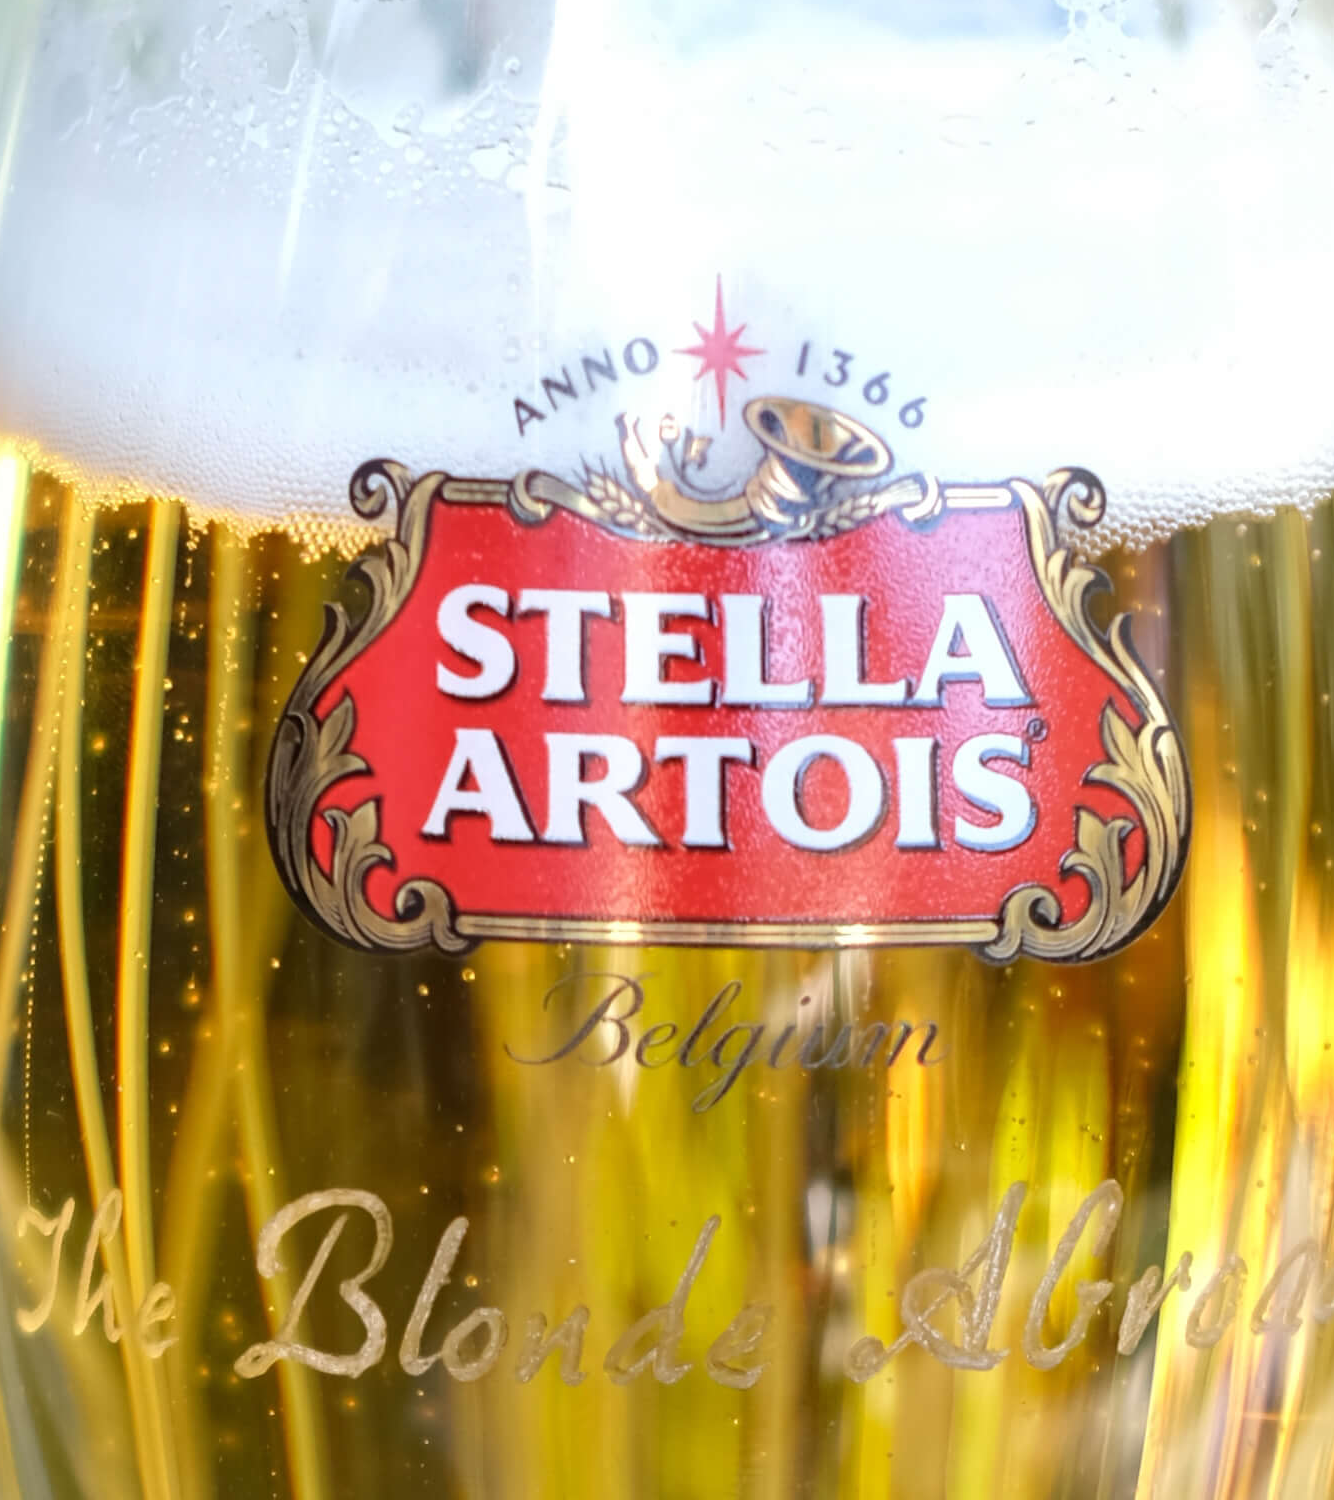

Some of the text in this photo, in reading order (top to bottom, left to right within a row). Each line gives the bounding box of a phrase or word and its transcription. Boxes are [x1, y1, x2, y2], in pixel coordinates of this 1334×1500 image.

[512, 337, 928, 437] ANNO 1366
[434, 583, 1038, 709] STELLA
[419, 727, 1039, 854] ARTOIS
[503, 971, 949, 1115] Belgium
[16, 1186, 179, 1359] The
[233, 1187, 771, 1391] Blonde
